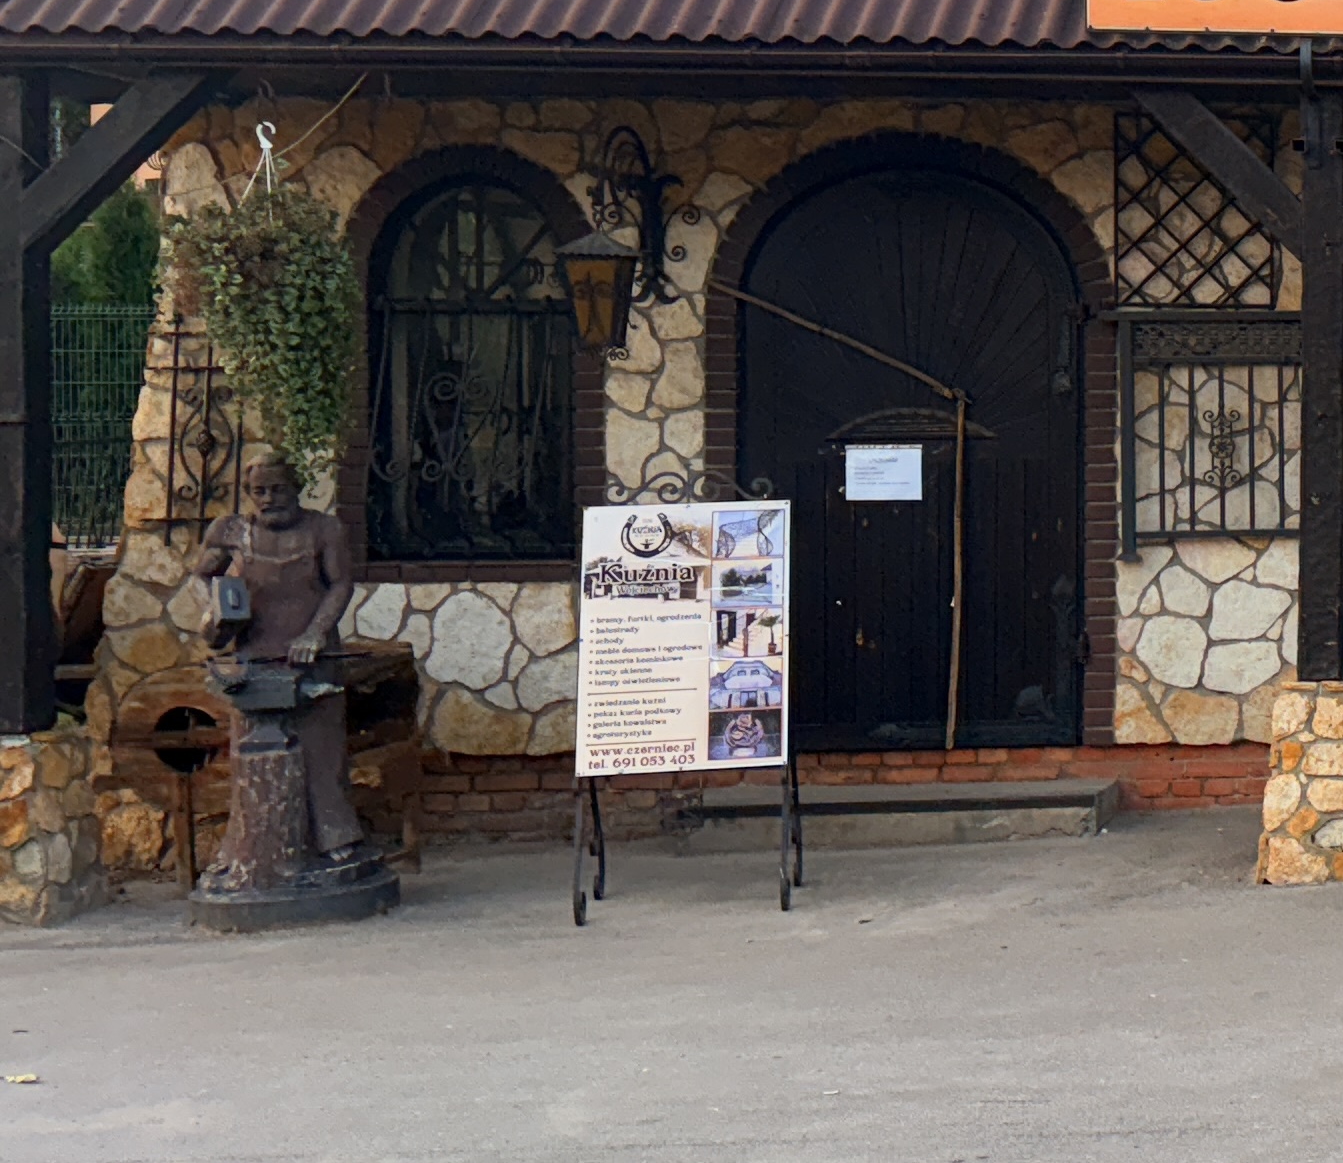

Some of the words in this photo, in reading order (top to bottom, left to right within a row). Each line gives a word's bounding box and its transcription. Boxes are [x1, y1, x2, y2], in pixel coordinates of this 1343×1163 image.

[589, 741, 695, 757] www.czerniec.pl
[588, 759, 608, 769] tel.
[613, 757, 636, 768] 691
[640, 755, 666, 766] 053
[670, 754, 695, 765] 403
